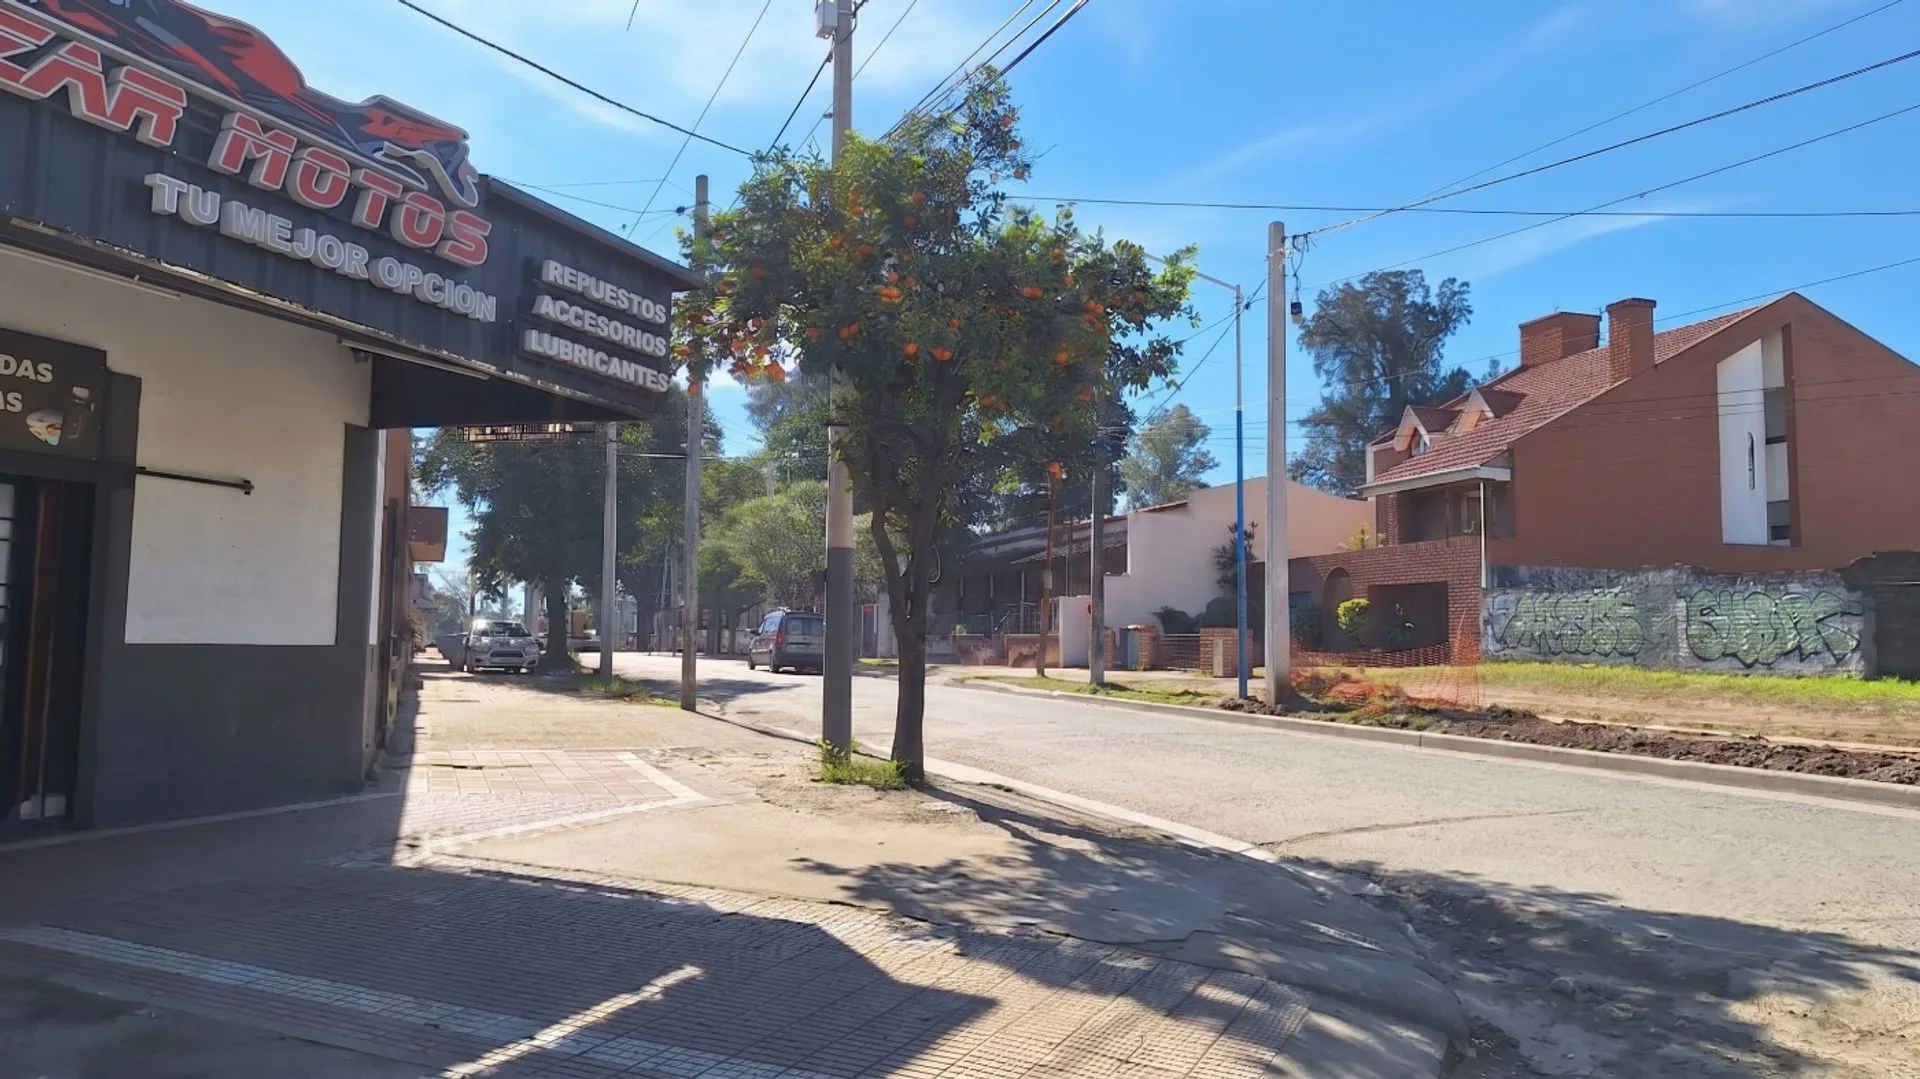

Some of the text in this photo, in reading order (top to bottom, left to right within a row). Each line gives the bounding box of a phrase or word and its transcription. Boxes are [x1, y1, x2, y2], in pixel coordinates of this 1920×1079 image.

[207, 111, 492, 268] MOTOS
[144, 173, 220, 226] TU
[220, 201, 369, 280] MEJOR
[542, 259, 667, 324] REPUESTOS
[531, 295, 667, 357] ACCESORIOS
[524, 329, 669, 393] LUBRICANTES
